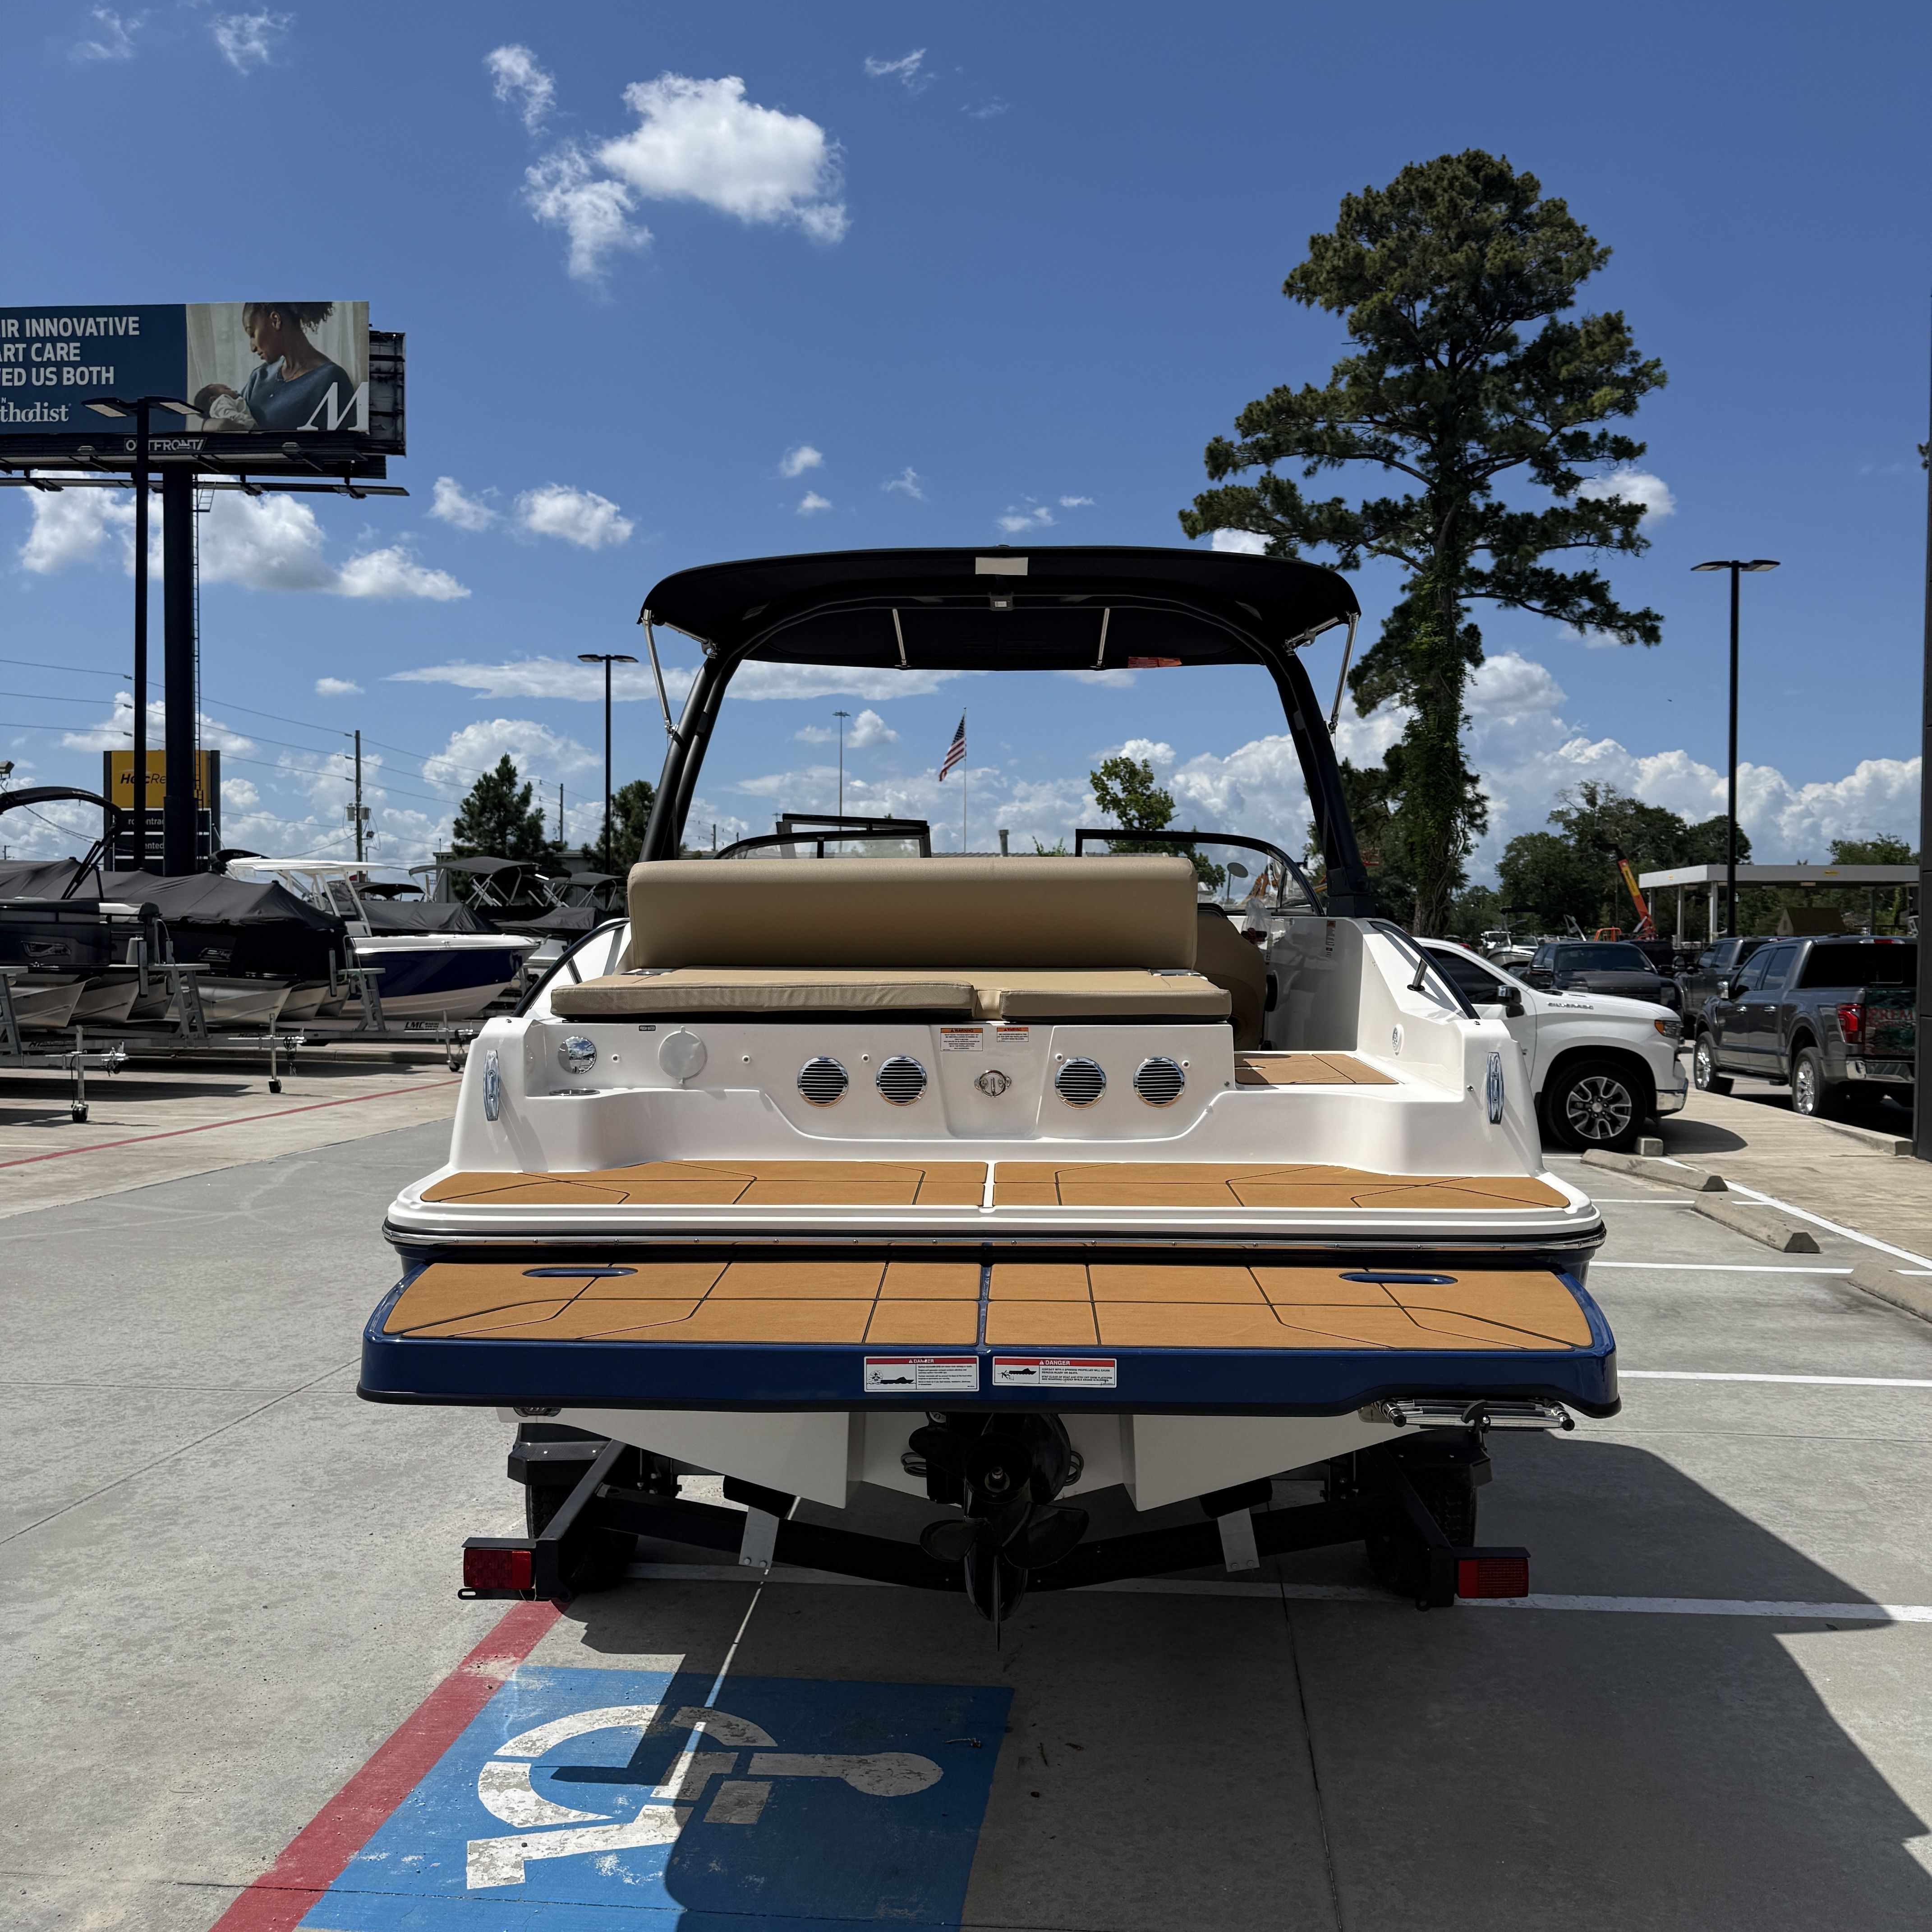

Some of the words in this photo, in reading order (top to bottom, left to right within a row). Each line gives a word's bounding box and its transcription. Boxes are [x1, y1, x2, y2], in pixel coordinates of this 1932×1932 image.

[0, 319, 19, 337] IR
[26, 317, 140, 337] INNOVATIVE
[0, 344, 27, 362] RT
[31, 343, 81, 362] CARE
[0, 368, 27, 386] ED
[32, 367, 57, 386] US
[63, 366, 114, 386] BOTH
[296, 382, 369, 434] M
